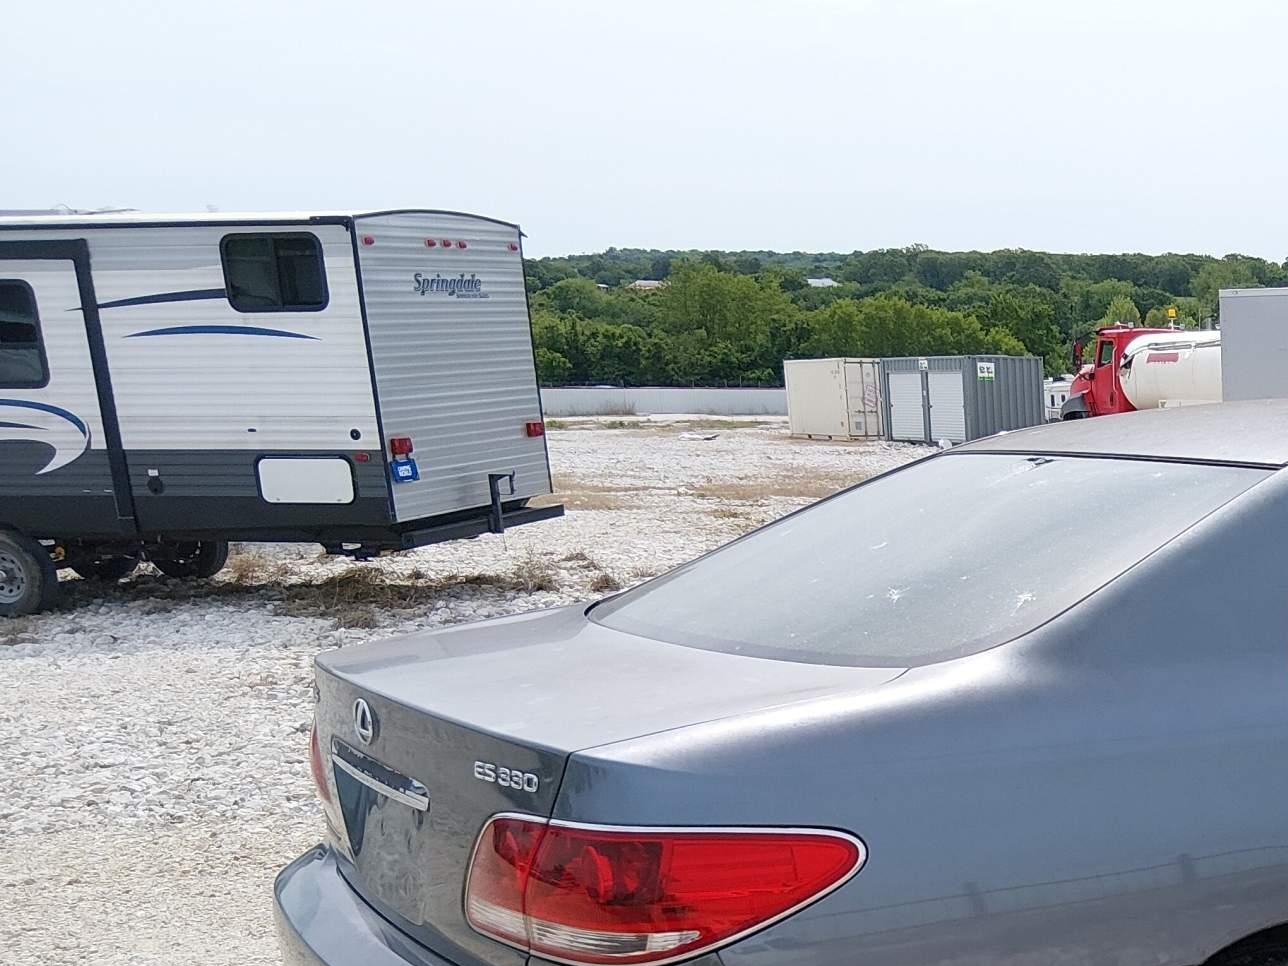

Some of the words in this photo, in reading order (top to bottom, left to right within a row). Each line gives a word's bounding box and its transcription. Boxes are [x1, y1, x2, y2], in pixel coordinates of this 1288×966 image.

[413, 273, 482, 296] Springdale
[474, 760, 497, 783] ES
[498, 766, 539, 793] 330
